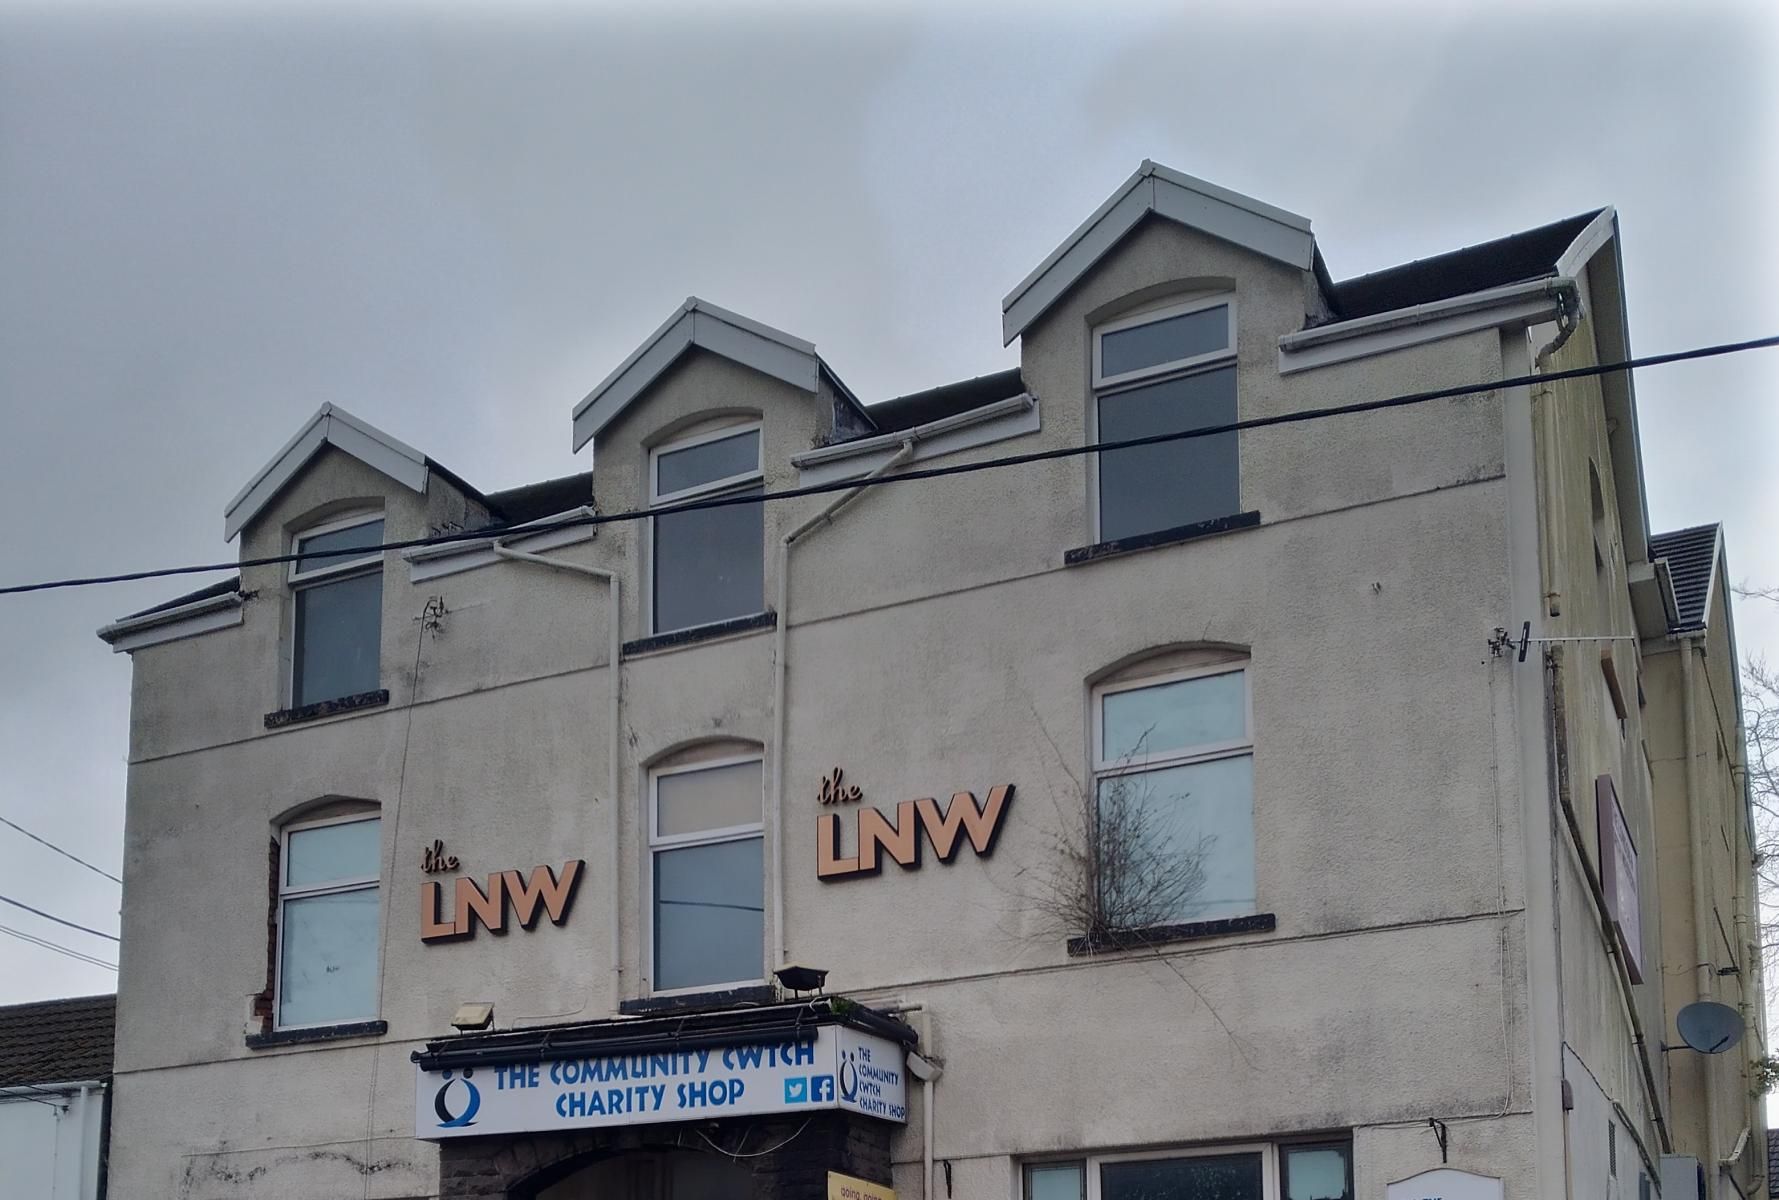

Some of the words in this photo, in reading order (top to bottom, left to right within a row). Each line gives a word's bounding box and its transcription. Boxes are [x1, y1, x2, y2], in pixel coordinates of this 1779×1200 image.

[817, 766, 863, 804] the
[817, 783, 1016, 881] LNW
[421, 839, 460, 873] the
[421, 859, 585, 945] LNW
[494, 1064, 540, 1090] THE
[550, 1050, 711, 1086] COMMUNITY
[722, 1040, 815, 1071] CWTCH
[858, 1047, 871, 1063] THE
[859, 1063, 899, 1086] COMMUNITY
[859, 1081, 881, 1097] CWTCH
[556, 1084, 666, 1118] CHARITY
[677, 1078, 745, 1109] SHOP
[860, 1096, 887, 1115] CHARITY
[889, 1104, 905, 1119] SHOP
